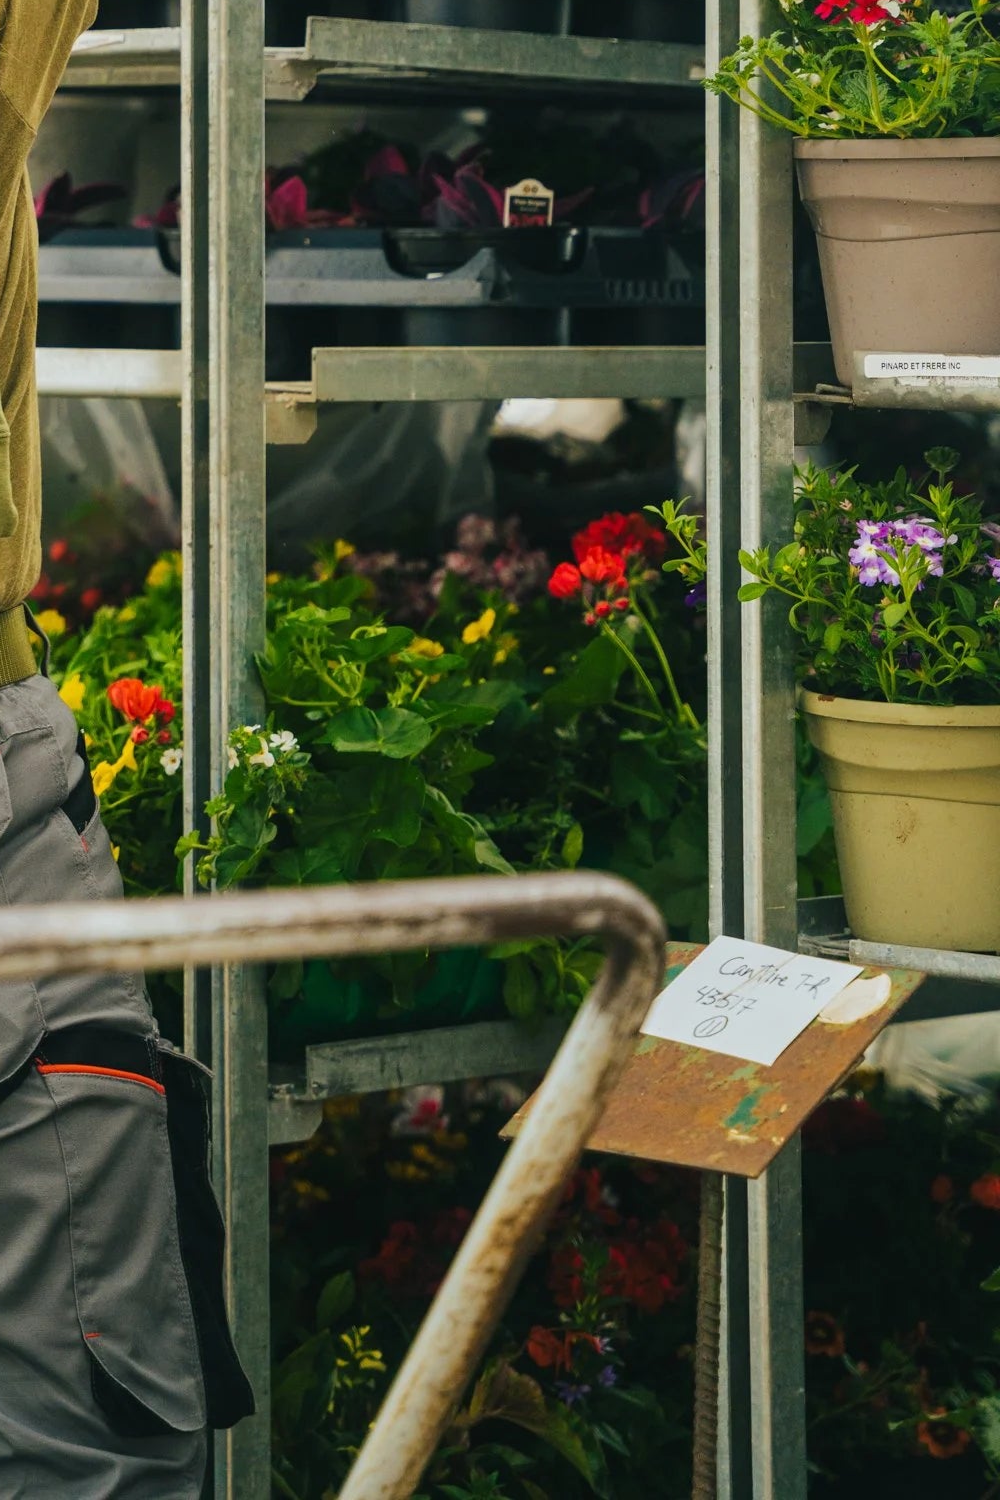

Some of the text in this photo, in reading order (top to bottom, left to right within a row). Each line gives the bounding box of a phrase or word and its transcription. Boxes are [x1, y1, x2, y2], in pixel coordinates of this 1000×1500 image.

[881, 362, 961, 370] PINARD ET FRERE INC
[696, 985, 758, 1015] 43517
